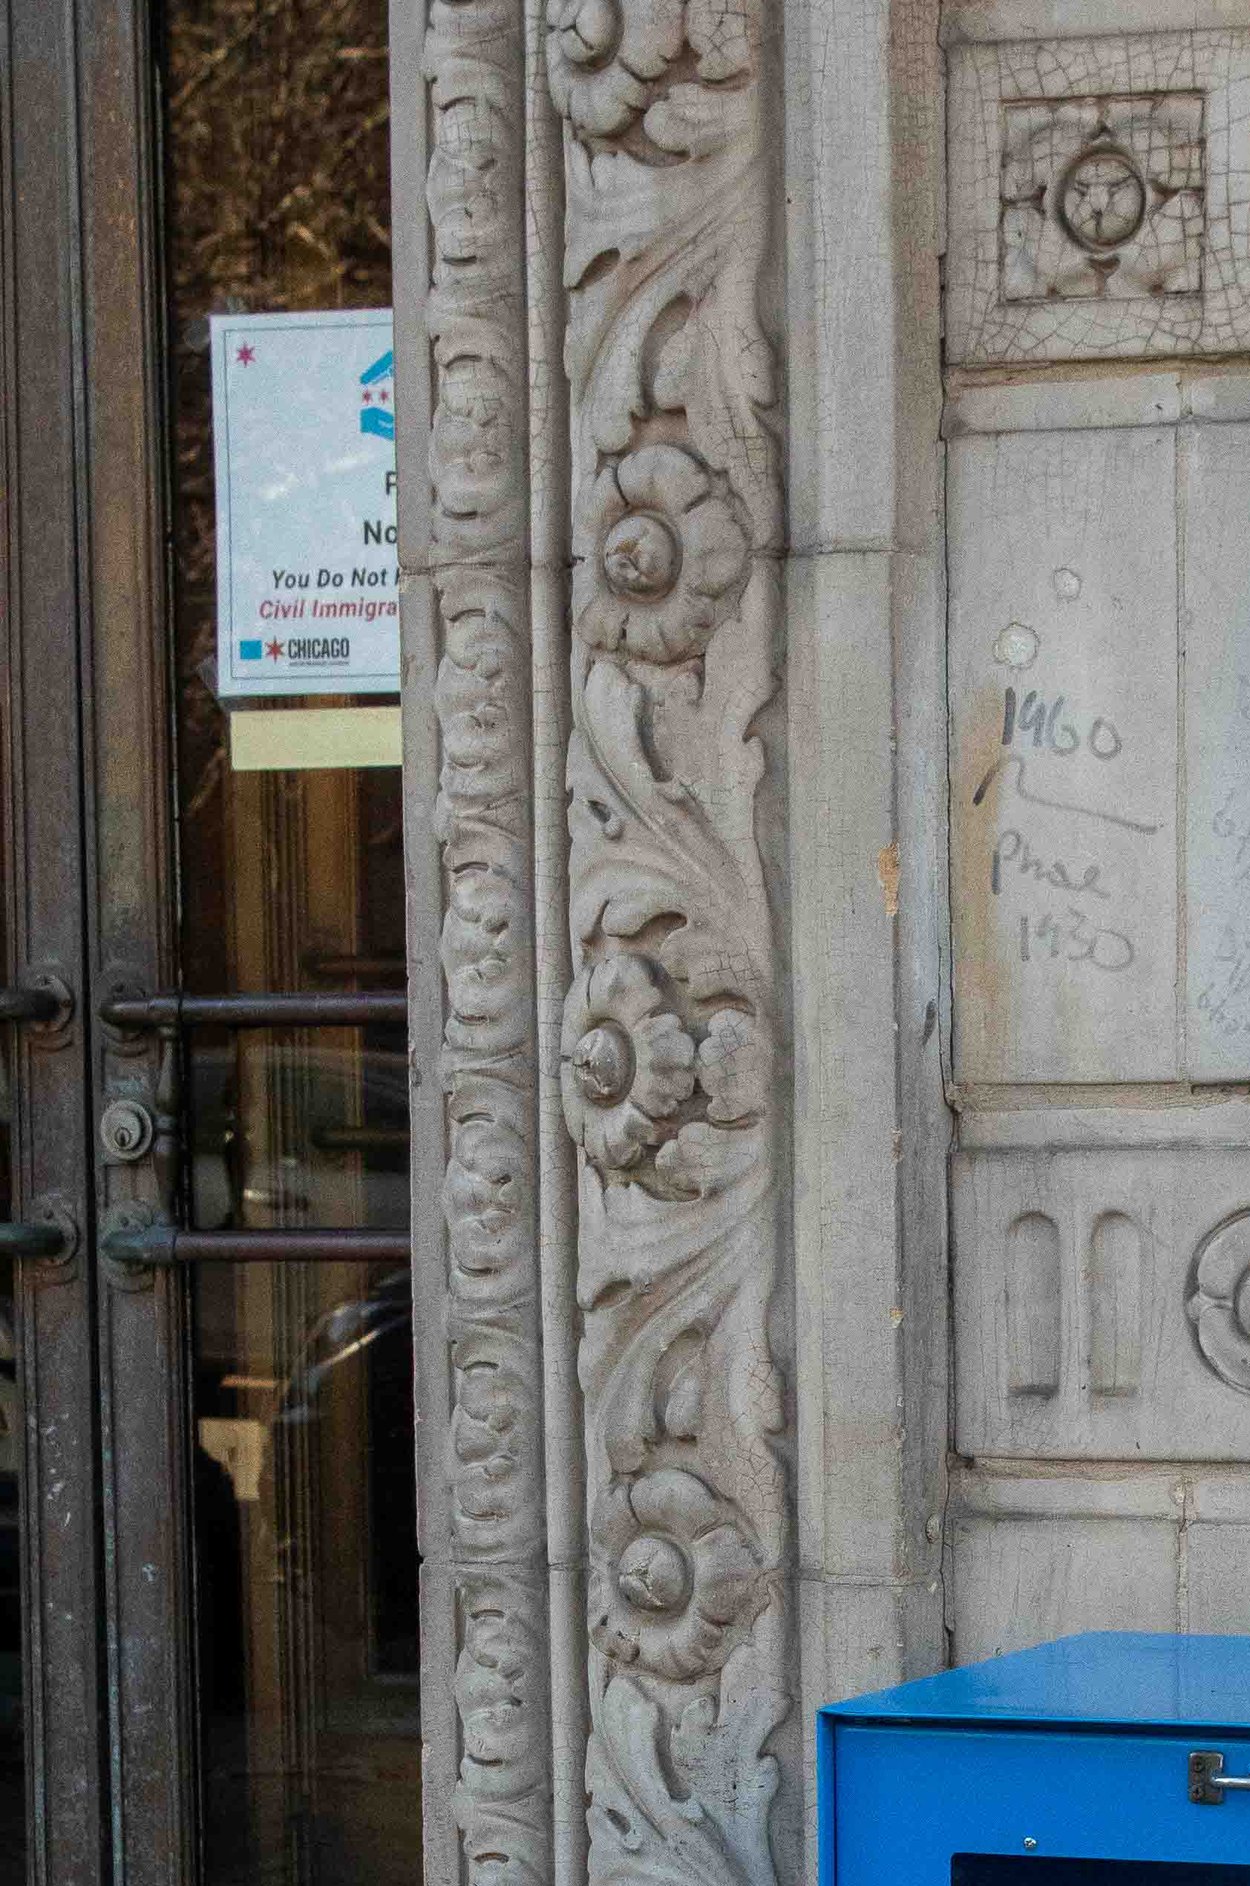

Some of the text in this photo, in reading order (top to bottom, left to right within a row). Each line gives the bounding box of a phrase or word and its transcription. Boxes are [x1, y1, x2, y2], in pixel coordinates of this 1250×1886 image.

[272, 569, 309, 588] You
[316, 568, 343, 588] Do
[350, 567, 387, 587] Not
[259, 599, 305, 619] Civil
[288, 637, 350, 659] CHICAGO
